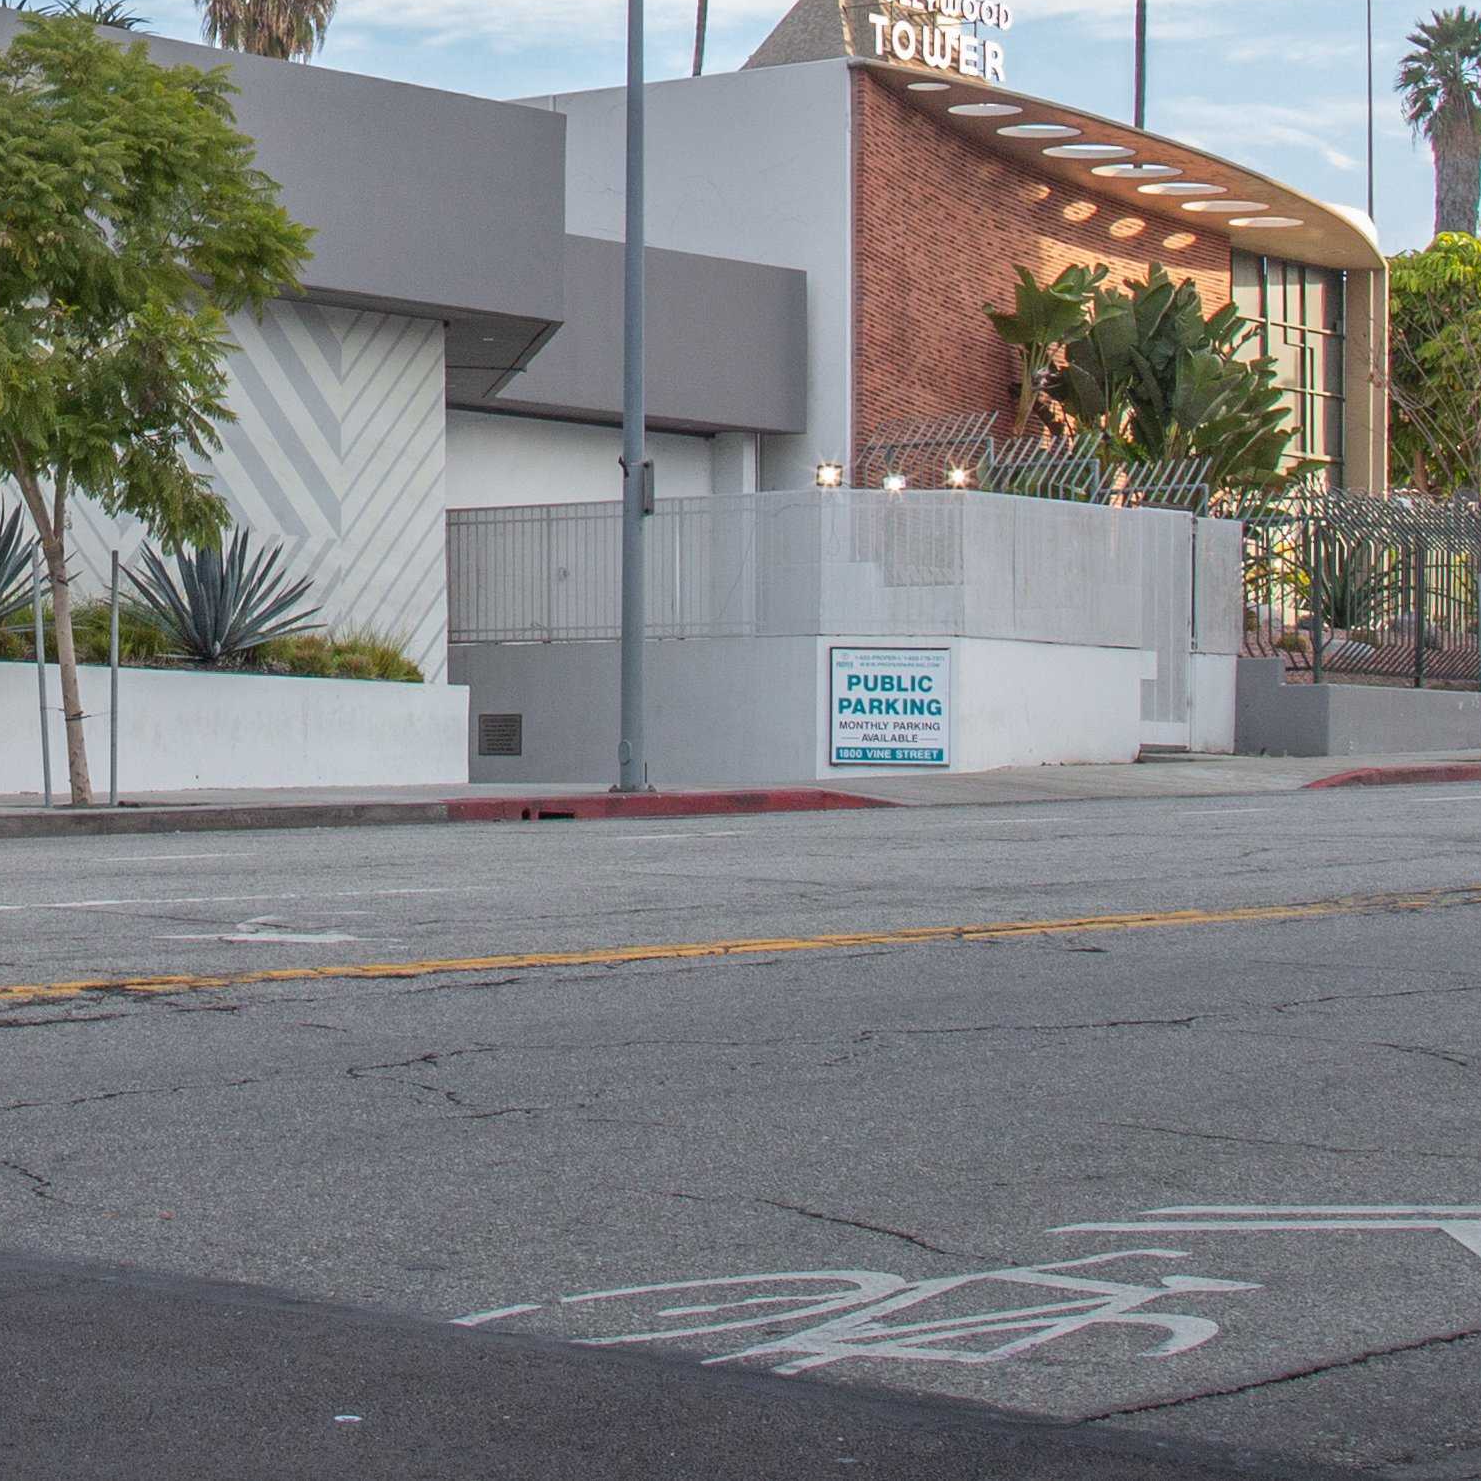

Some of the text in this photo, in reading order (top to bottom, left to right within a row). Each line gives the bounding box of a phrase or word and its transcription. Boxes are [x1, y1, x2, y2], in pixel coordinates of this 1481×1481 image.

[869, 12, 1006, 82] TOWER
[847, 674, 934, 693] PUBLIC
[838, 697, 943, 716] PARKING
[838, 721, 941, 731] MONTHLY PARKING
[861, 733, 919, 743] AVAILABLE
[866, 748, 892, 759] VINE
[895, 749, 939, 760] STREET
